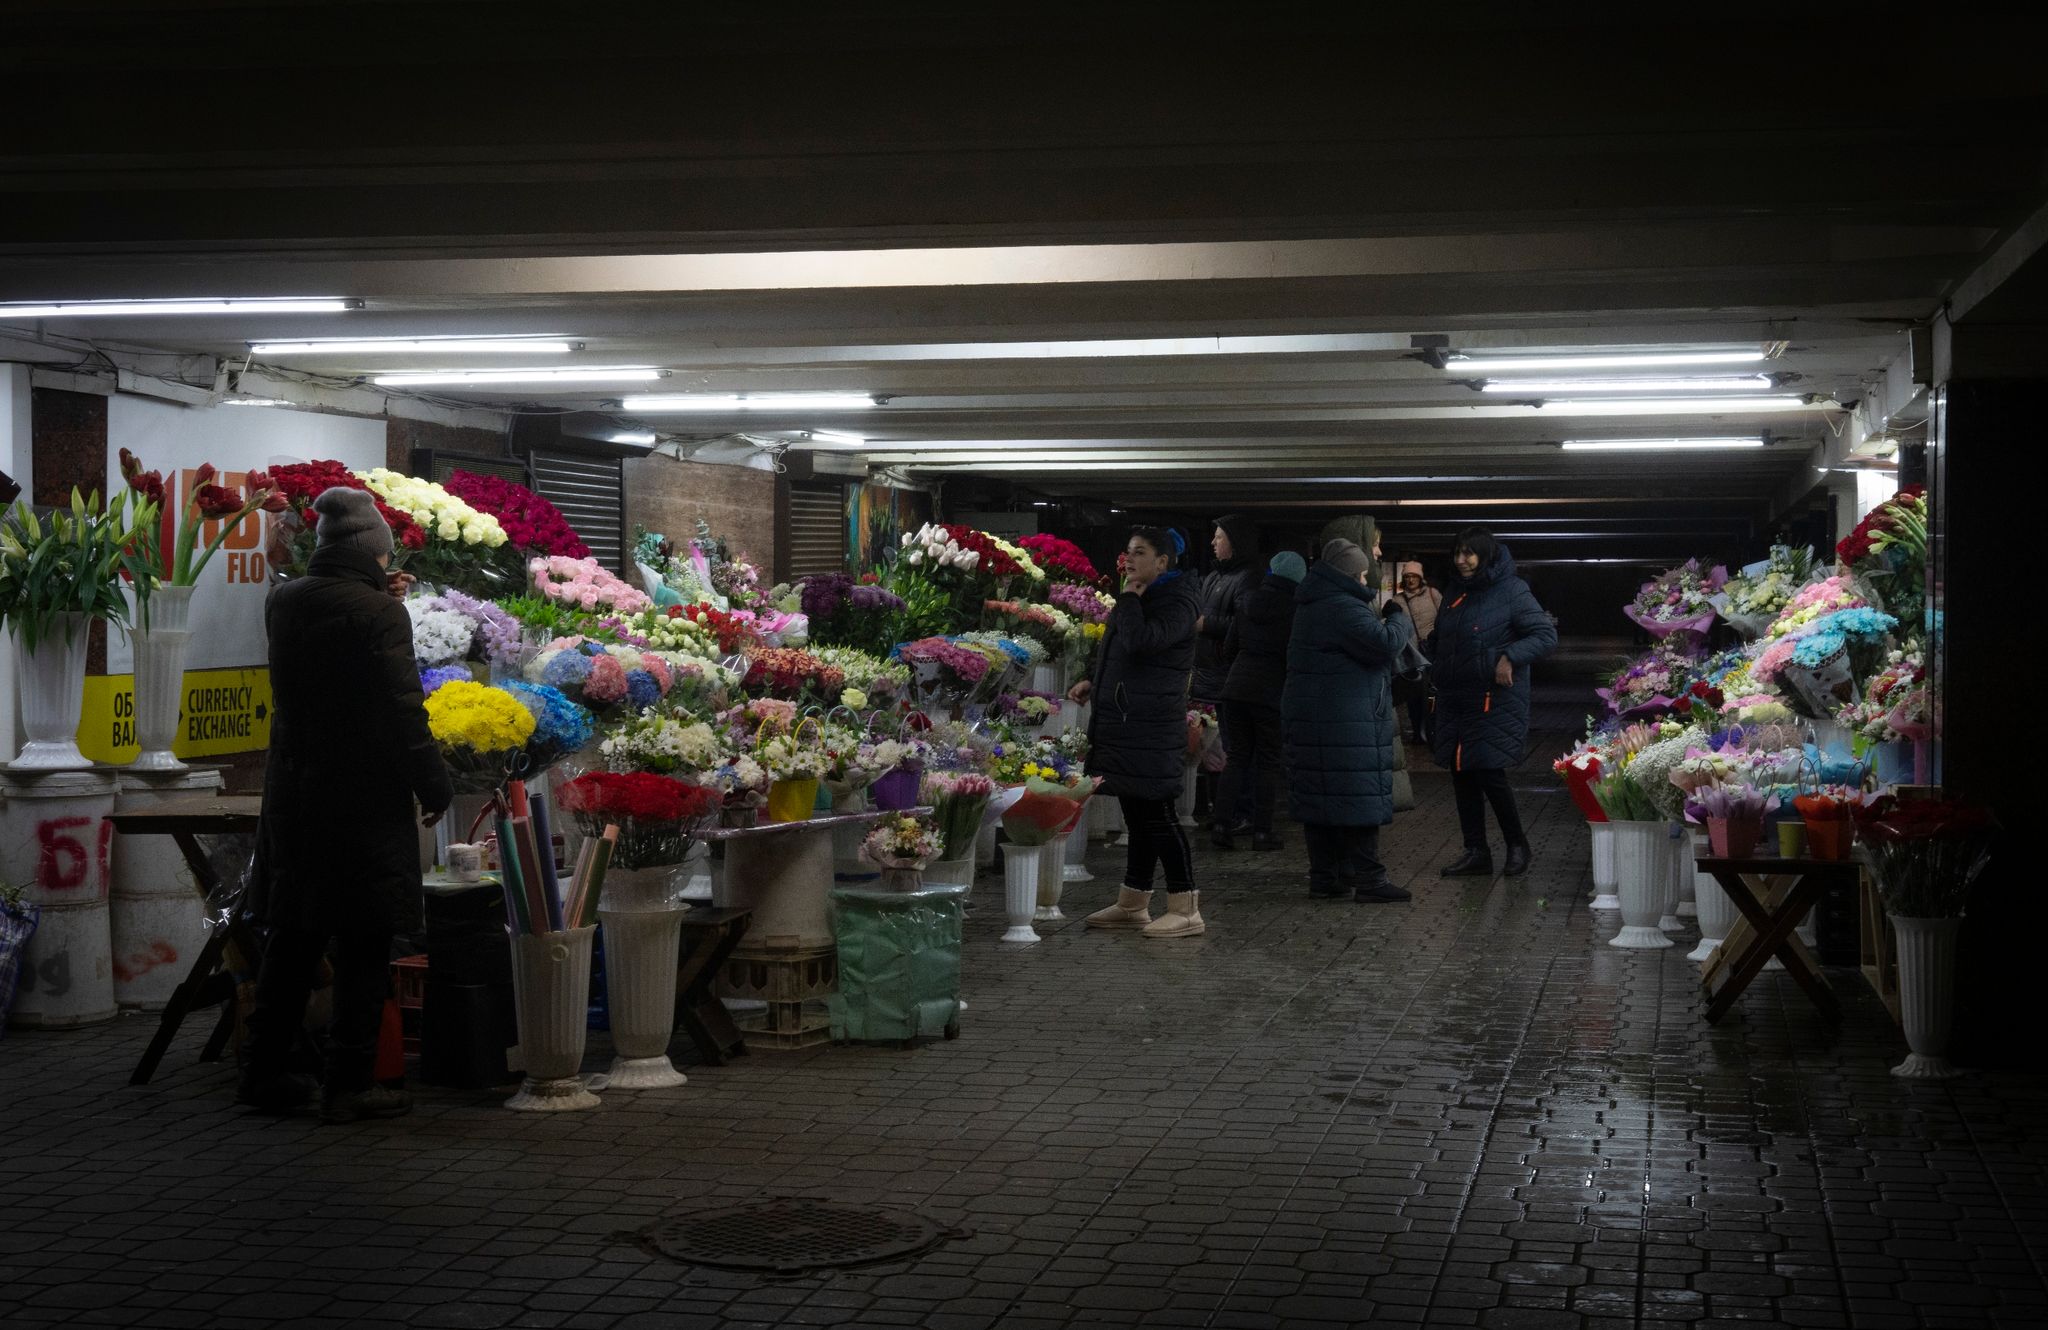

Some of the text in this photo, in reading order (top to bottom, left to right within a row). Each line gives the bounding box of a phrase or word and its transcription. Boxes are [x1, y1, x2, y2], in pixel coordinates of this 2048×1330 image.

[227, 552, 265, 584] FLO
[188, 686, 252, 713] CURRENCY
[188, 713, 251, 741] EXCHANGE
